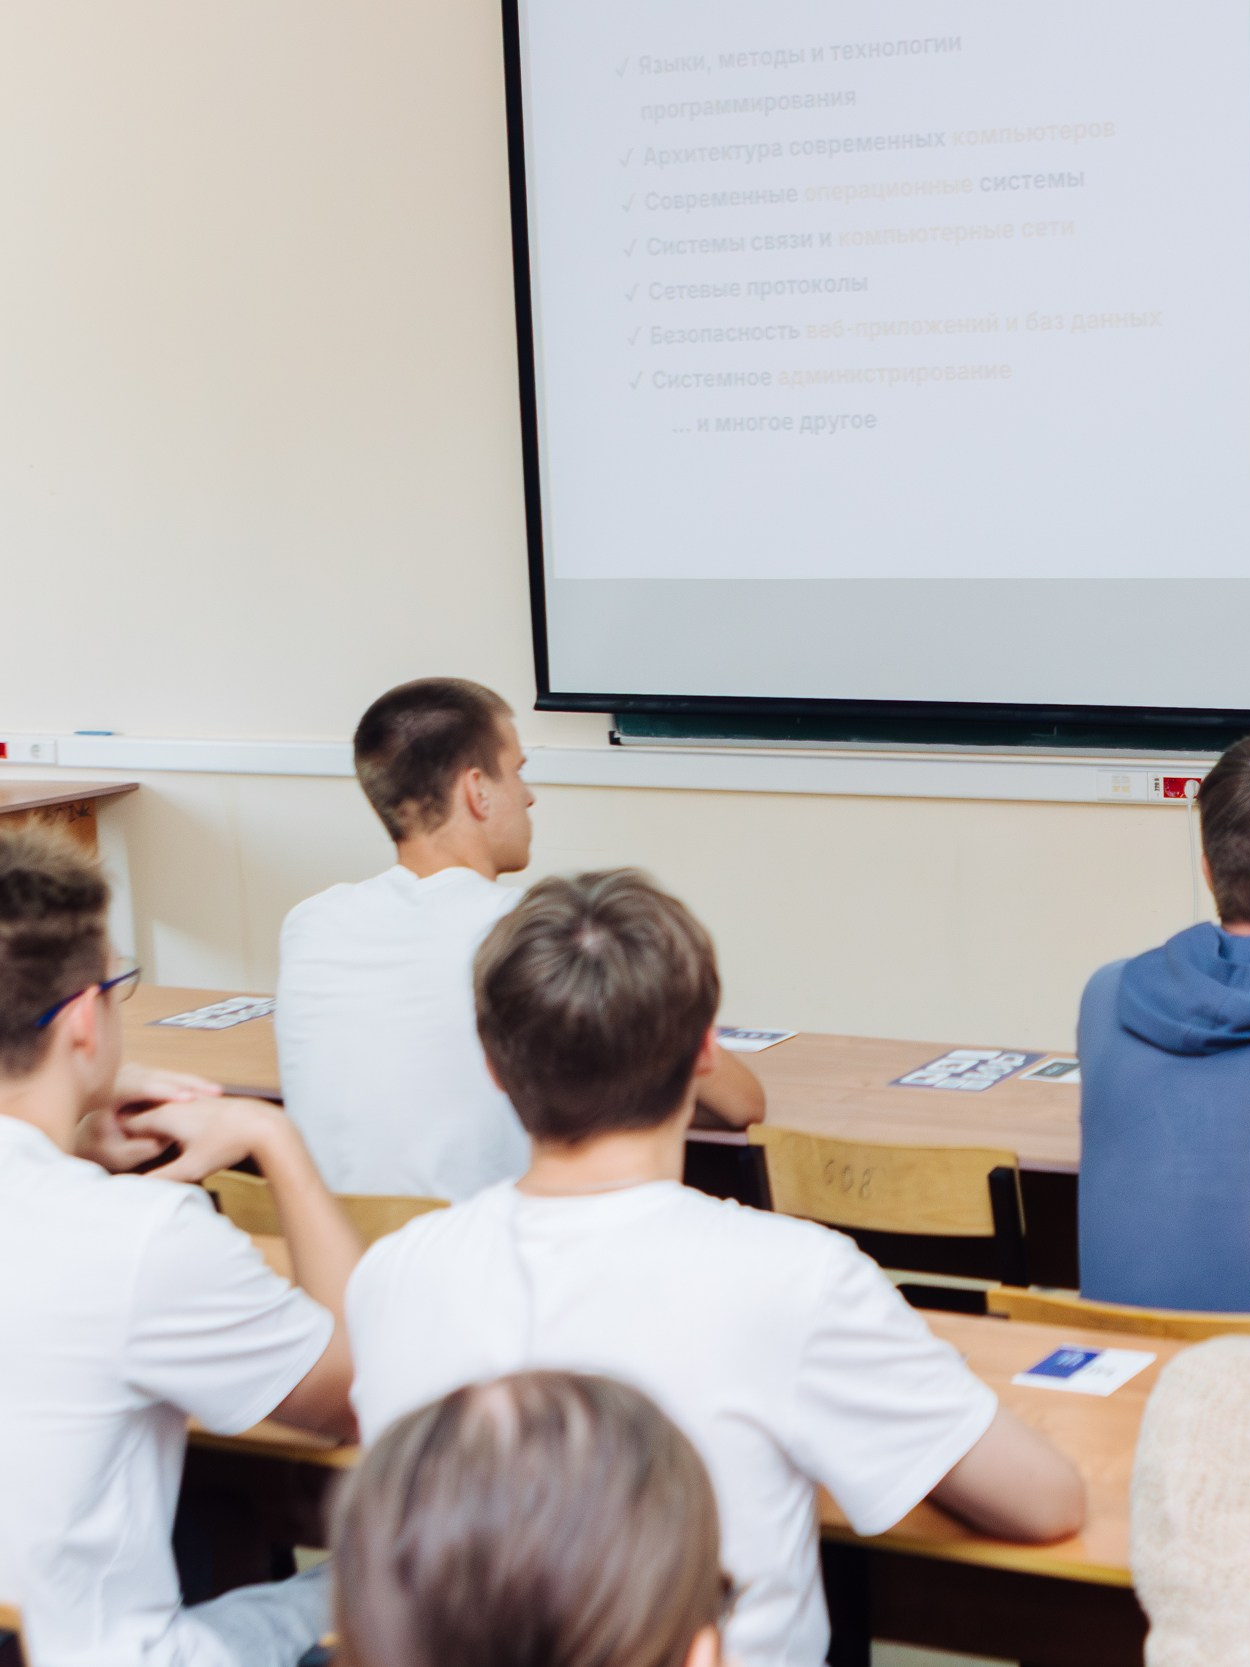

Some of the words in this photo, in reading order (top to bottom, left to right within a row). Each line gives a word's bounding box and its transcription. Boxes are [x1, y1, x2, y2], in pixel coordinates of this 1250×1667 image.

[638, 53, 712, 75] Языки,
[719, 49, 805, 70] методы
[811, 46, 824, 63] и
[829, 34, 962, 61] технологии
[640, 89, 857, 124] программирования
[643, 140, 783, 170] Архитектура
[789, 130, 946, 159] современных
[951, 119, 1116, 147] компьютеров
[644, 185, 798, 213] Современные
[804, 175, 973, 205] операционные
[979, 170, 1085, 192] системы
[646, 235, 745, 256] Системы
[751, 232, 813, 251] связи
[819, 231, 832, 248] и
[838, 220, 1014, 247] компьютерные
[1021, 218, 1075, 238] сети
[648, 281, 740, 301] Сетевые
[747, 275, 868, 301] протоколы
[650, 323, 800, 345] Безопасность
[806, 312, 999, 342] веб-приложений
[1007, 317, 1019, 332] и
[1026, 310, 1065, 331] баз
[1071, 309, 1163, 334] данных
[652, 370, 772, 390] Системное
[779, 362, 1013, 389] администрирование
[697, 417, 709, 433] и
[715, 415, 794, 433] многое
[800, 412, 878, 435] другое
